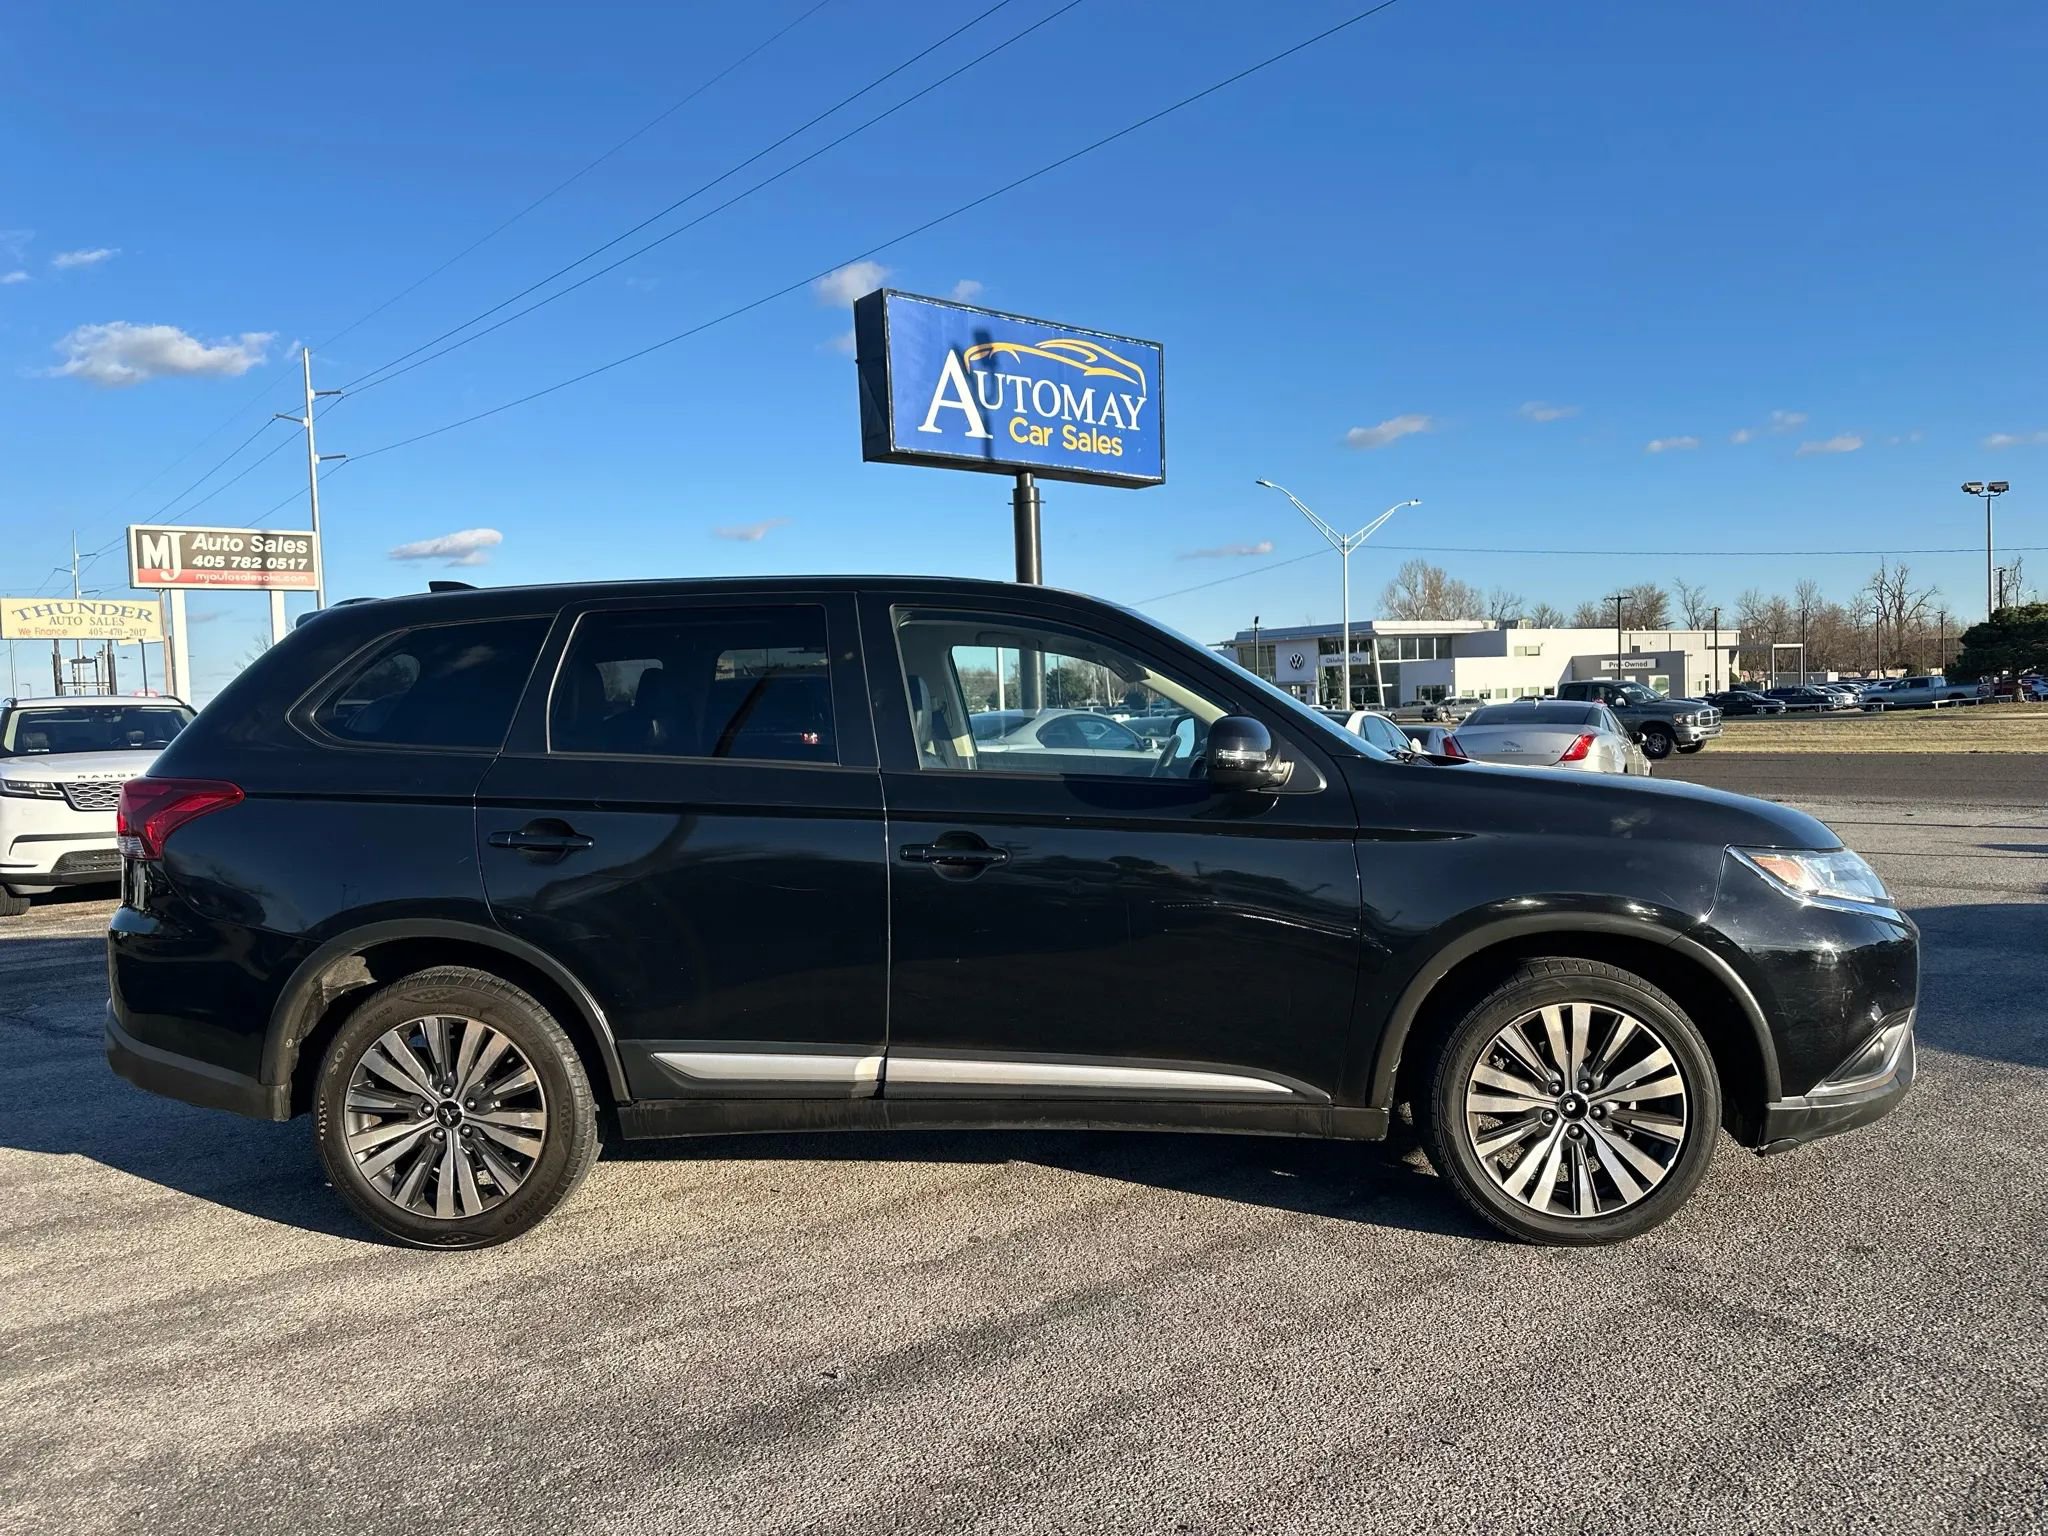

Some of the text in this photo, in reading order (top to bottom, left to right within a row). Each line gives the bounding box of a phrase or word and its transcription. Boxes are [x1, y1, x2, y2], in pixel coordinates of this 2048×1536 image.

[917, 349, 1147, 439] AUTOMAY
[1009, 416, 1123, 457] Car Sales
[191, 533, 308, 554] Auto Sales
[141, 532, 187, 581] MJ
[191, 554, 308, 570] 405 782 0517
[12, 602, 153, 623] THUNDER
[49, 616, 126, 627] AUTO SALES
[18, 628, 32, 636] We
[35, 627, 69, 636] Finance
